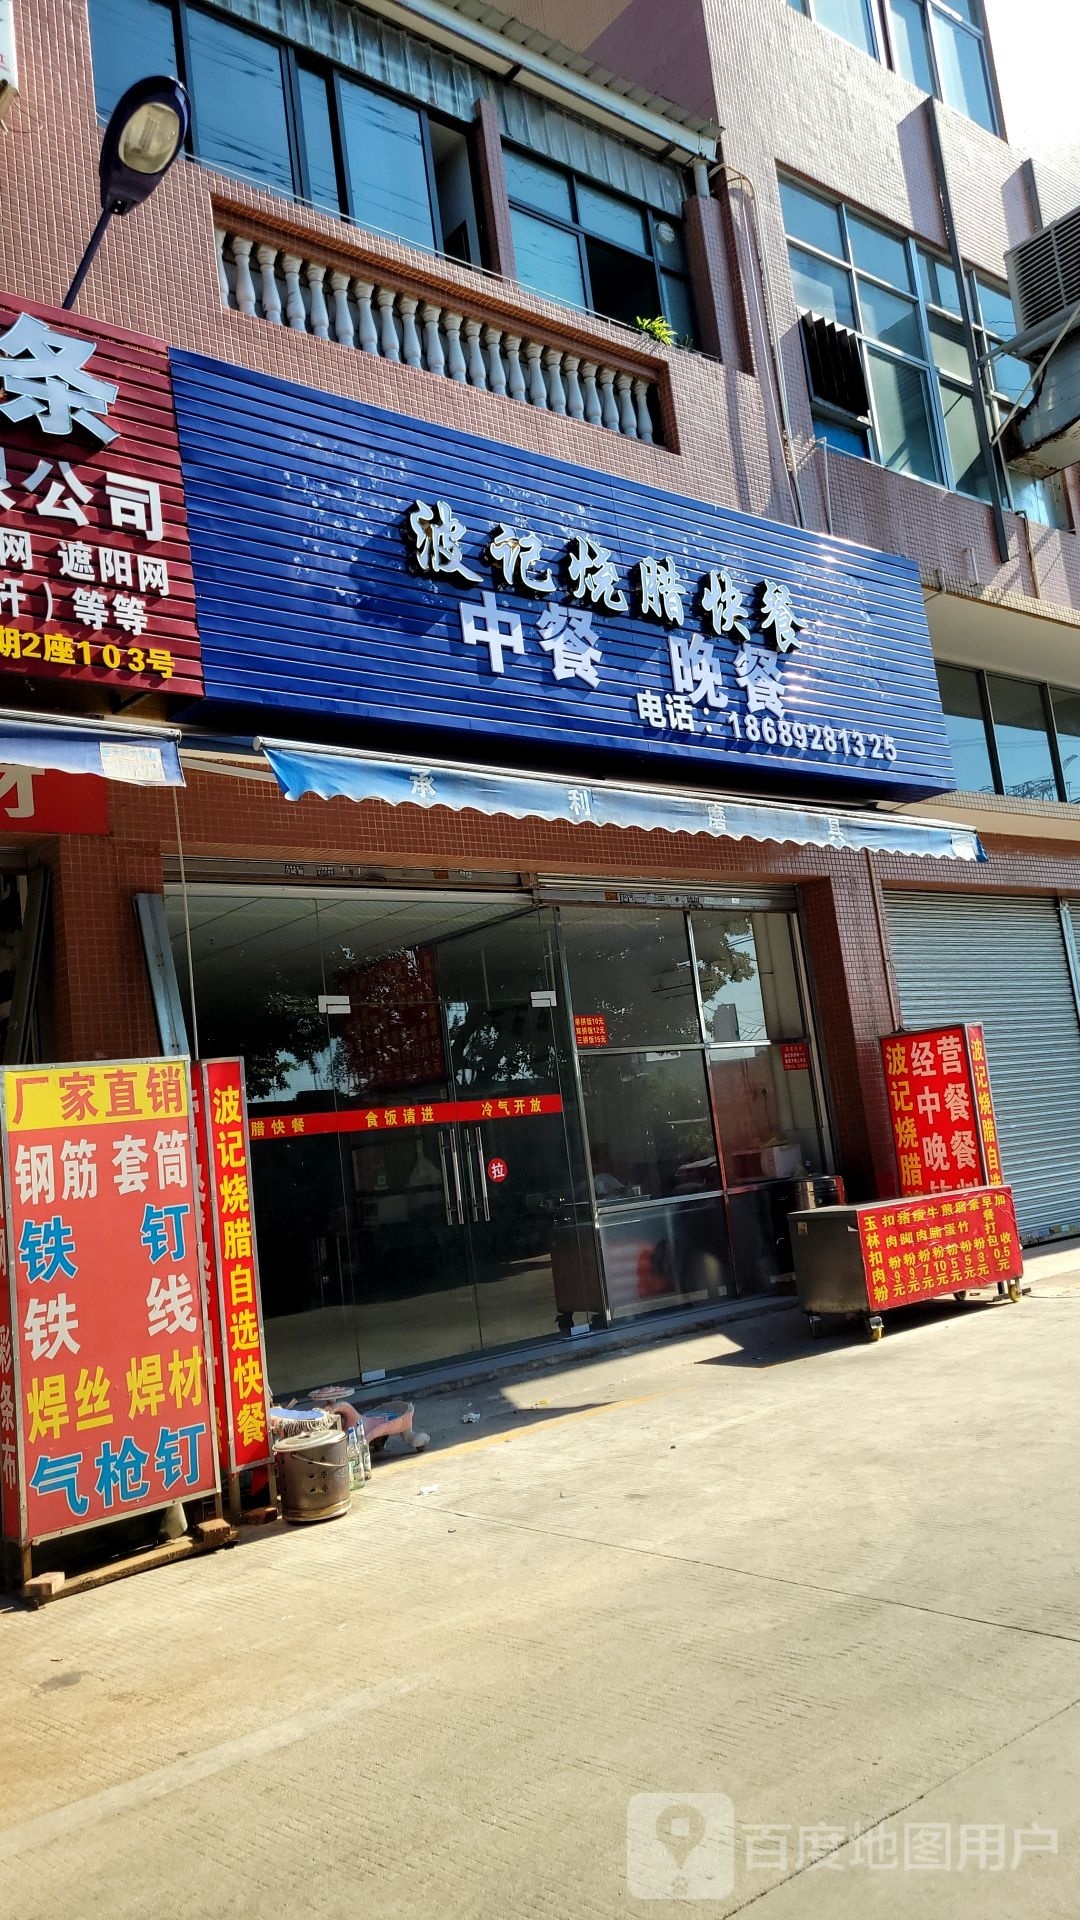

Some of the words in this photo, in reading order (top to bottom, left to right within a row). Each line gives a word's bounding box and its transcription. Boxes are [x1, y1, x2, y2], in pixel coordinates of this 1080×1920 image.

[0, 312, 121, 449] 条
[0, 446, 164, 541] 公司
[57, 541, 170, 597] 遮阳网
[412, 499, 807, 653] 波记烧腊快餐
[460, 591, 602, 689] 中餐
[668, 631, 789, 719] 晚餐
[911, 1035, 963, 1077] 经营
[12, 1066, 184, 1125] 厂家直销
[365, 1106, 434, 1128] 食饭请进
[481, 1098, 542, 1117] 冷气开放
[886, 1043, 924, 1196] 波记烧腊
[916, 1083, 969, 1124] 中餐
[251, 1117, 305, 1137] 腊快餐
[922, 1130, 977, 1172] 晚餐
[491, 1162, 505, 1179] 拉
[212, 1085, 267, 1448] 波记烧腊自选快餐
[863, 1215, 889, 1303] 玉林扣肉粉
[29, 1422, 206, 1517] 气枪钉
